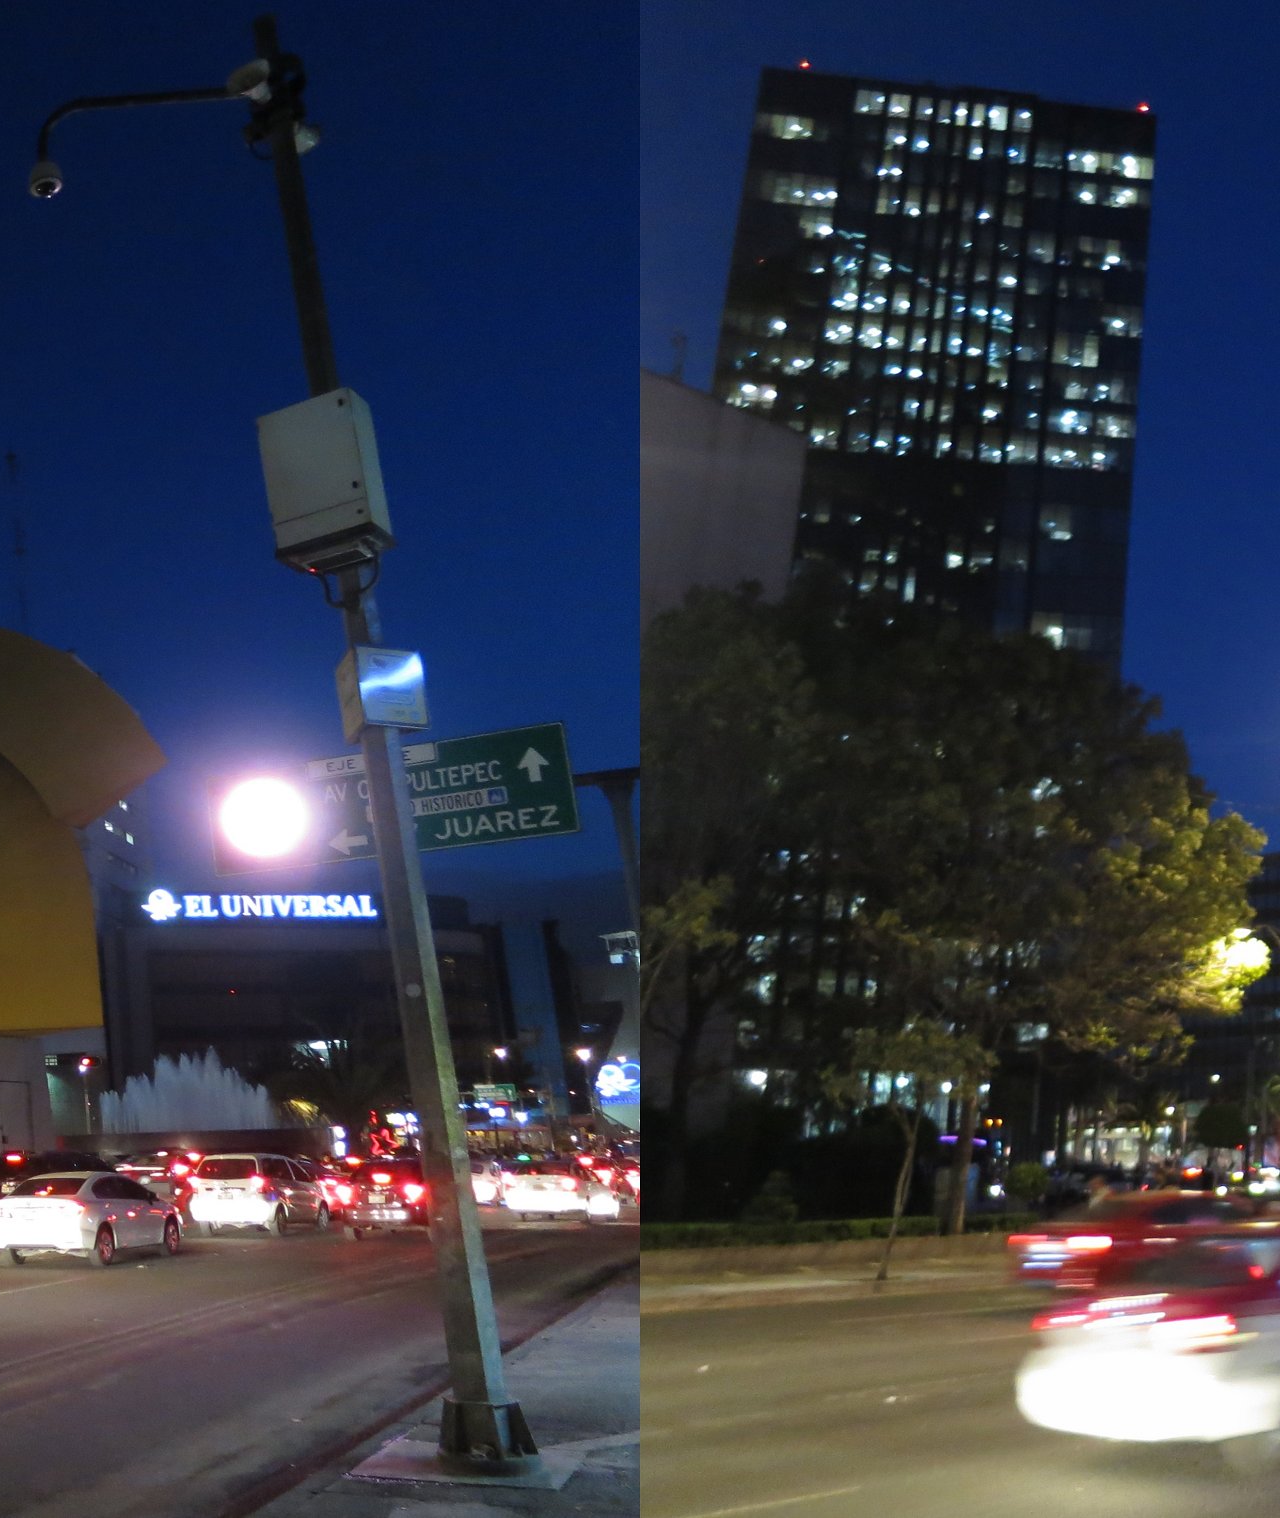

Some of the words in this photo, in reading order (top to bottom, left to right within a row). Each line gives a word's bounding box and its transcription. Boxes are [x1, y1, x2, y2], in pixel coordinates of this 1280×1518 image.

[326, 758, 356, 772] EJE
[324, 781, 347, 803] AV
[421, 791, 484, 813] HISTORICO
[435, 805, 561, 840] JUAREZ
[183, 894, 218, 918] EL
[220, 894, 378, 918] UNIVERSAL
